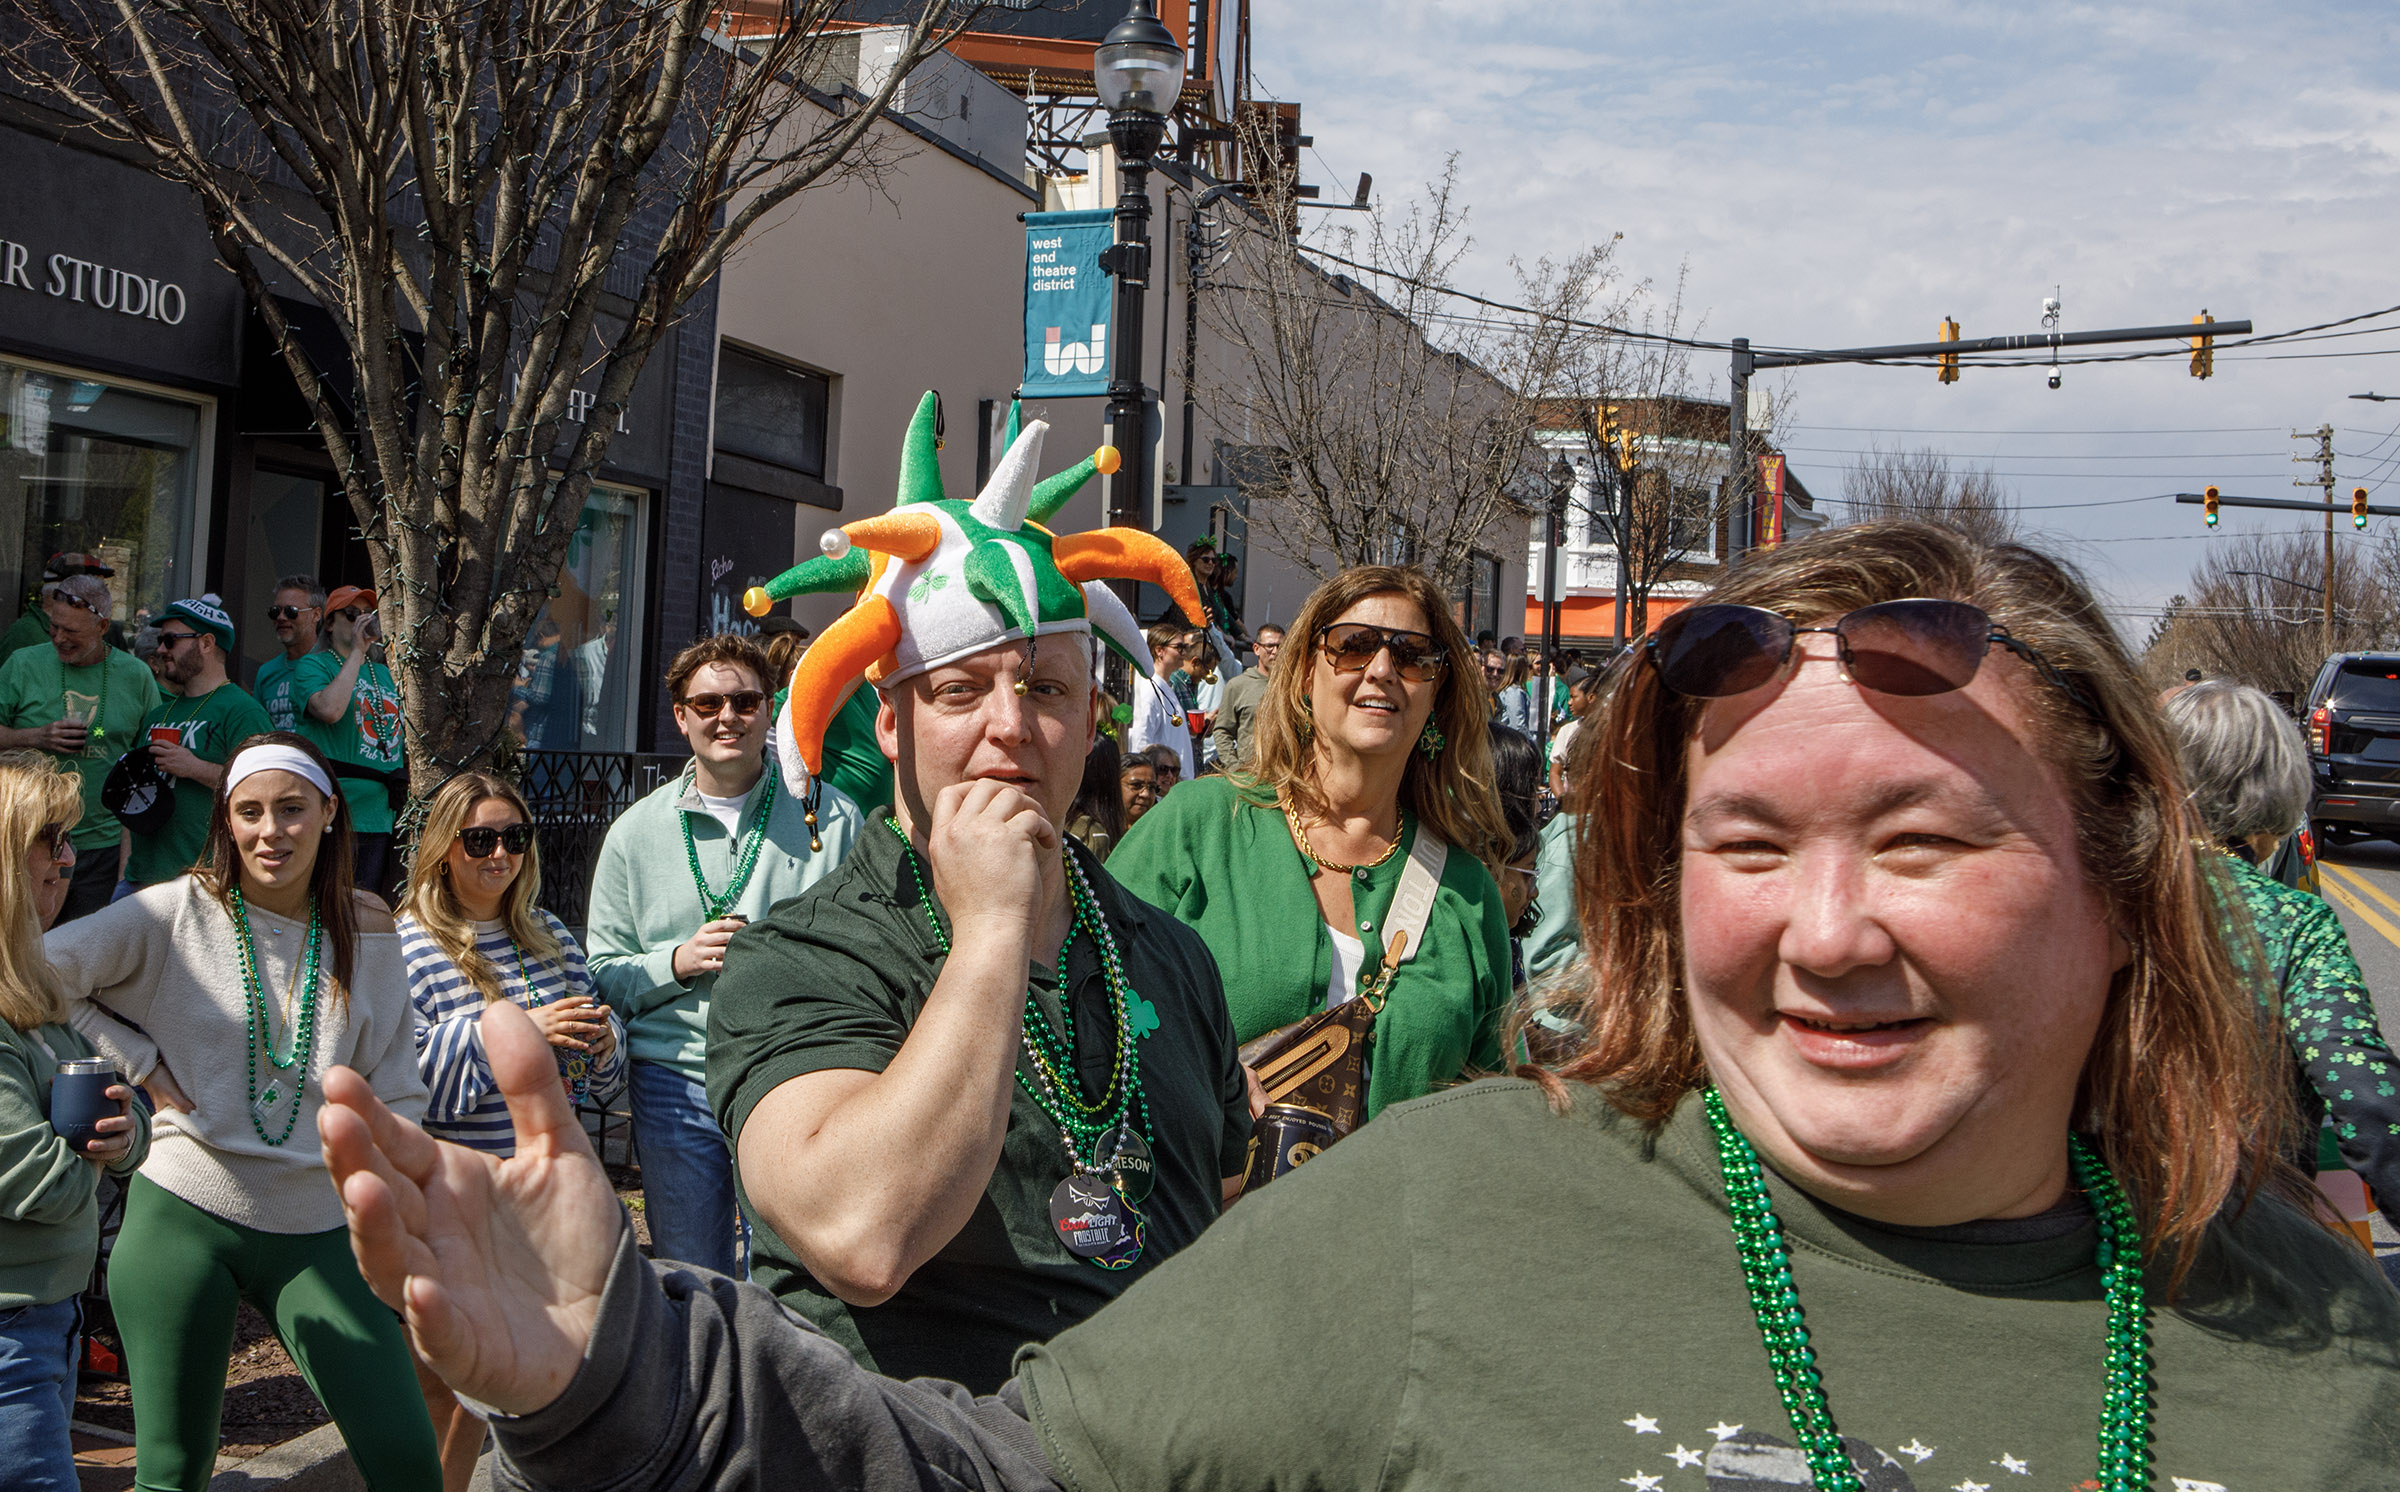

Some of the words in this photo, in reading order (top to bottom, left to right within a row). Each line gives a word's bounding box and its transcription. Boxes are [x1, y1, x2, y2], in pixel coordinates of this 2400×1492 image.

[1033, 236, 1062, 249] west
[1033, 251, 1056, 263] end
[1033, 265, 1076, 277] theatre
[46, 253, 186, 325] STUDIO
[1033, 278, 1075, 291] district
[643, 763, 679, 794] Th
[1100, 1156, 1150, 1174] MESON
[1059, 1217, 1089, 1232] Coors
[1088, 1215, 1118, 1228] LIGHT
[1073, 1228, 1111, 1247] FROSTBITE
